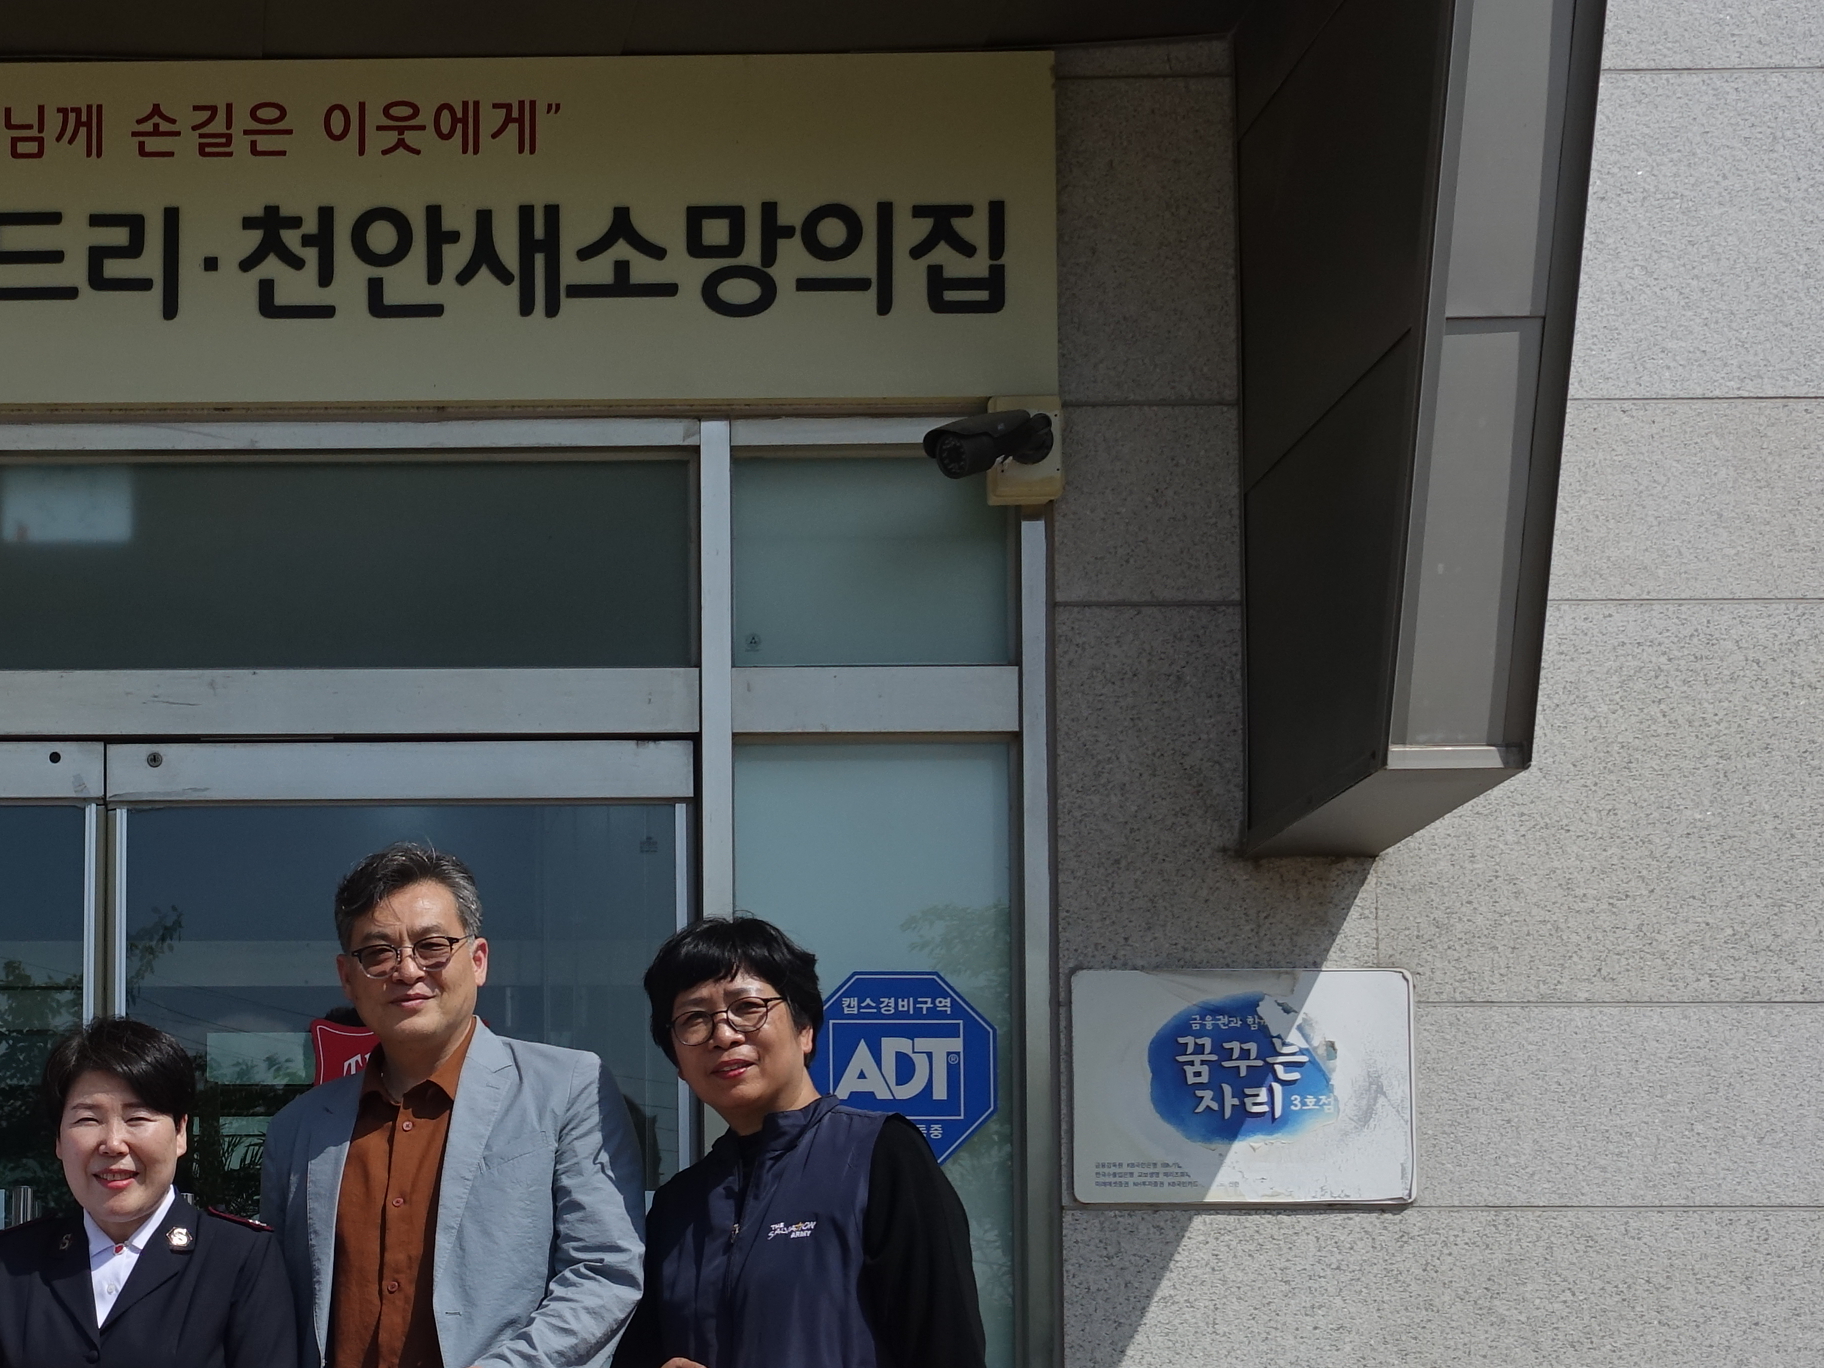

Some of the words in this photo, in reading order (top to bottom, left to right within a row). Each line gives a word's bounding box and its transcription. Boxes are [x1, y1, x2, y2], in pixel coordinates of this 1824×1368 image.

[130, 101, 294, 158] 손길은
[323, 99, 562, 157] 이웃에게”
[841, 997, 952, 1014] 캡스경비구역
[1189, 1014, 1243, 1030] 금융권과
[1175, 1035, 1311, 1085] 꿈꾸는
[1194, 1081, 1284, 1121] 자리
[1290, 1093, 1335, 1113] 3호점
[767, 1221, 817, 1240] SALVATION
[790, 1230, 812, 1238] ARMY
